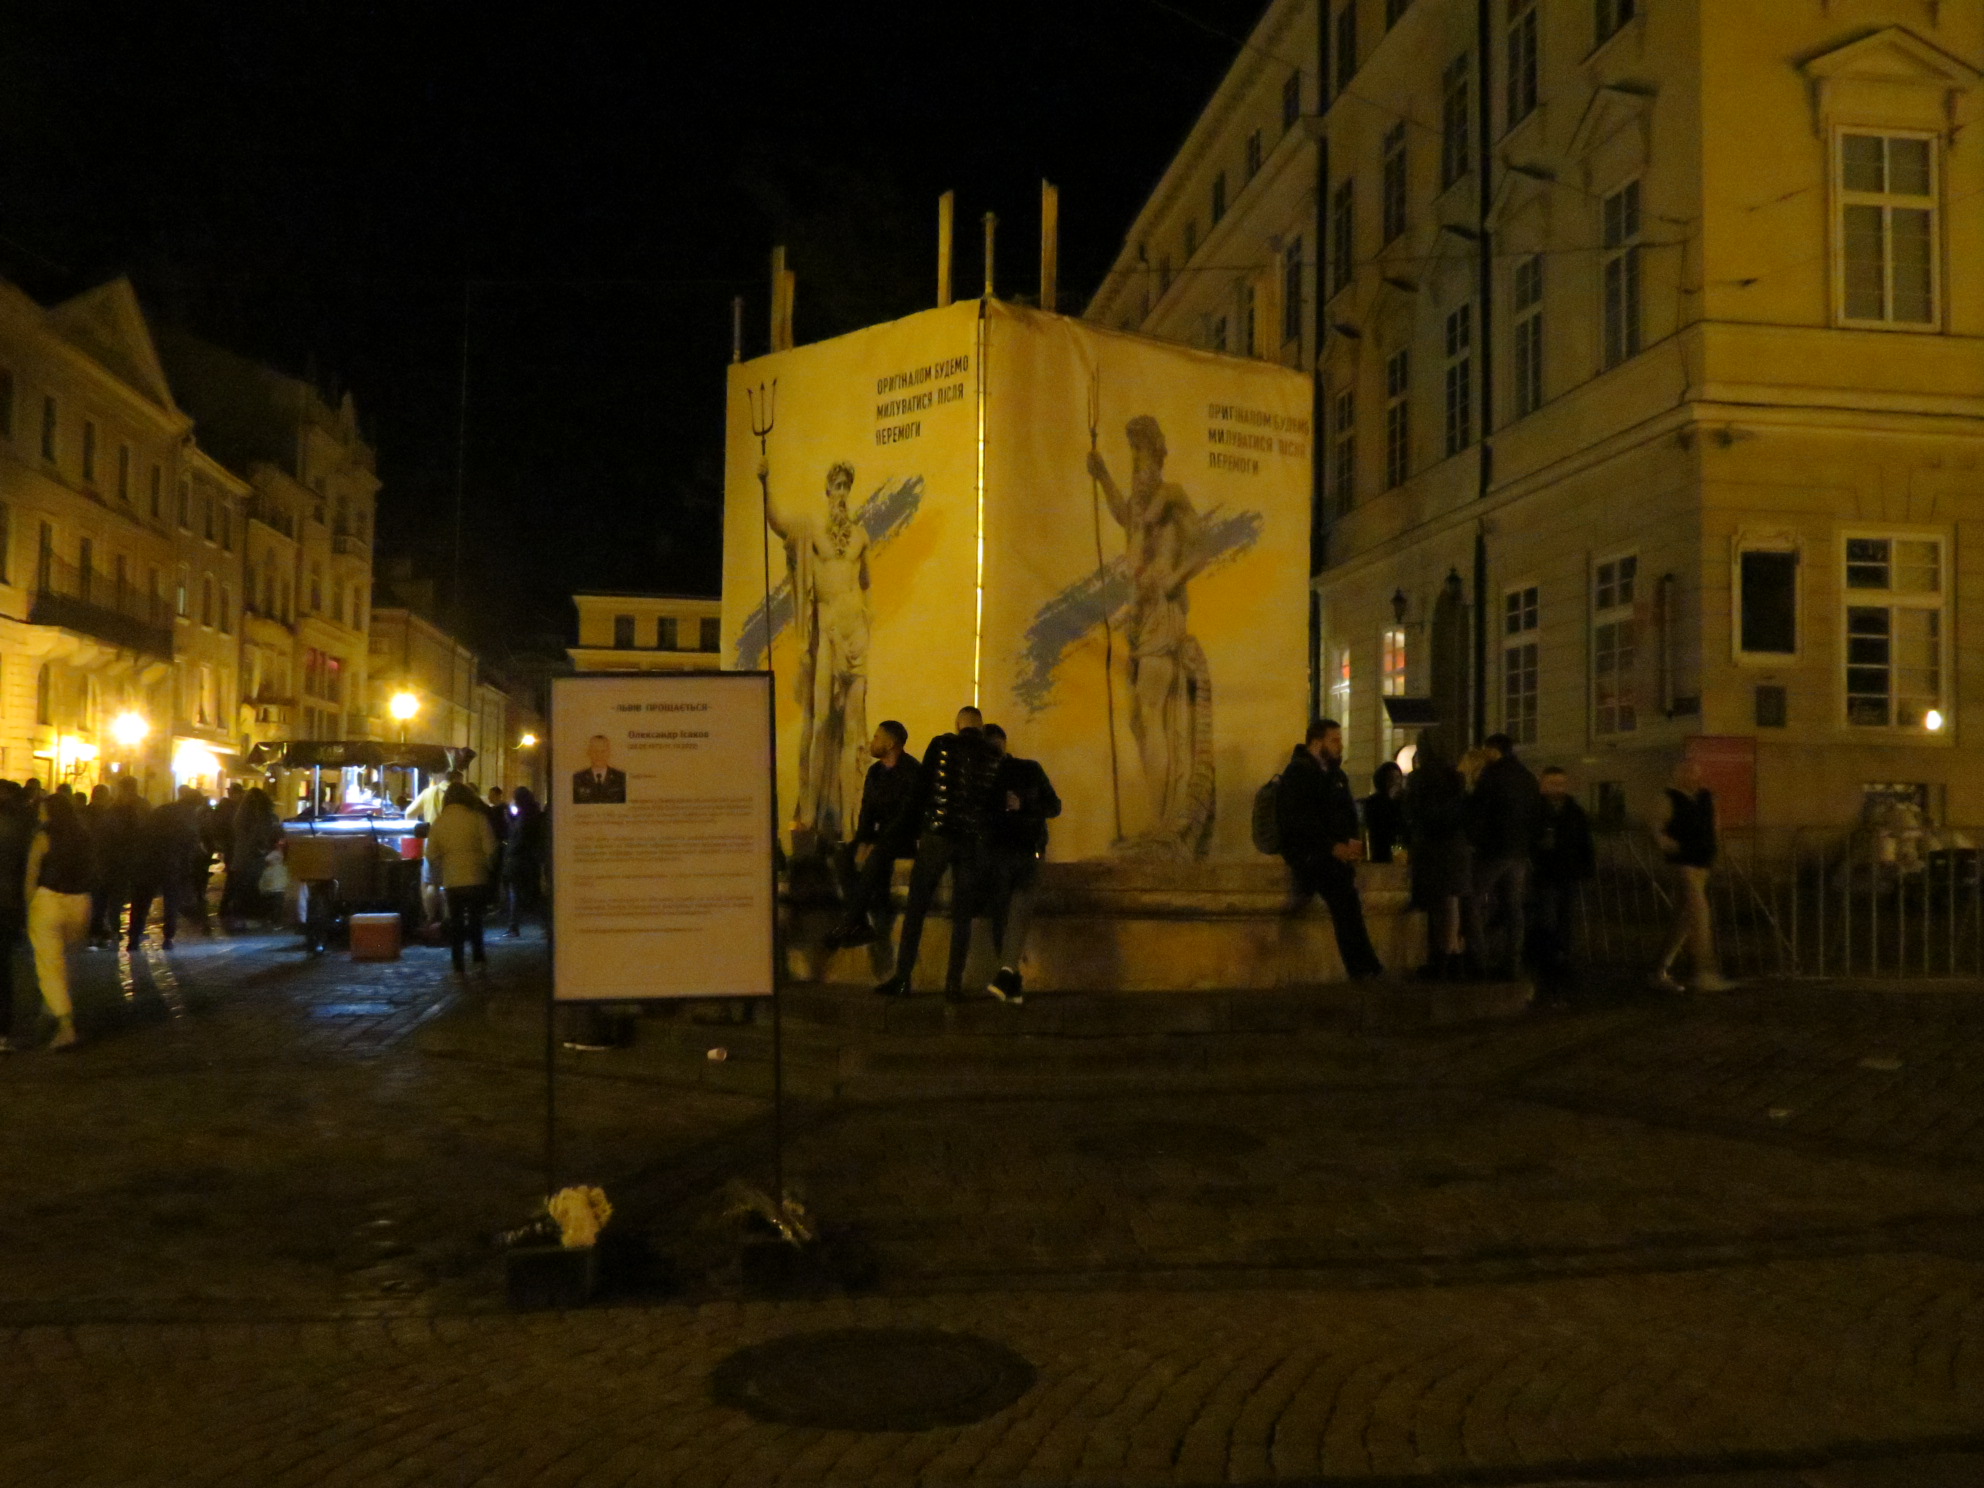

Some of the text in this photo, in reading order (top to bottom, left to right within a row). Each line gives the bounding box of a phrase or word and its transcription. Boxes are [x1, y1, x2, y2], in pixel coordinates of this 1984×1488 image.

[877, 355, 969, 395] ОРИГІНАЛОМ БУДЕМО
[876, 382, 964, 420] МИЛУВАТИСЯ ПІСЛЯ
[875, 421, 921, 446] ПЕРЕМОГИ
[1209, 452, 1259, 475] ПЕРЕМОГИ
